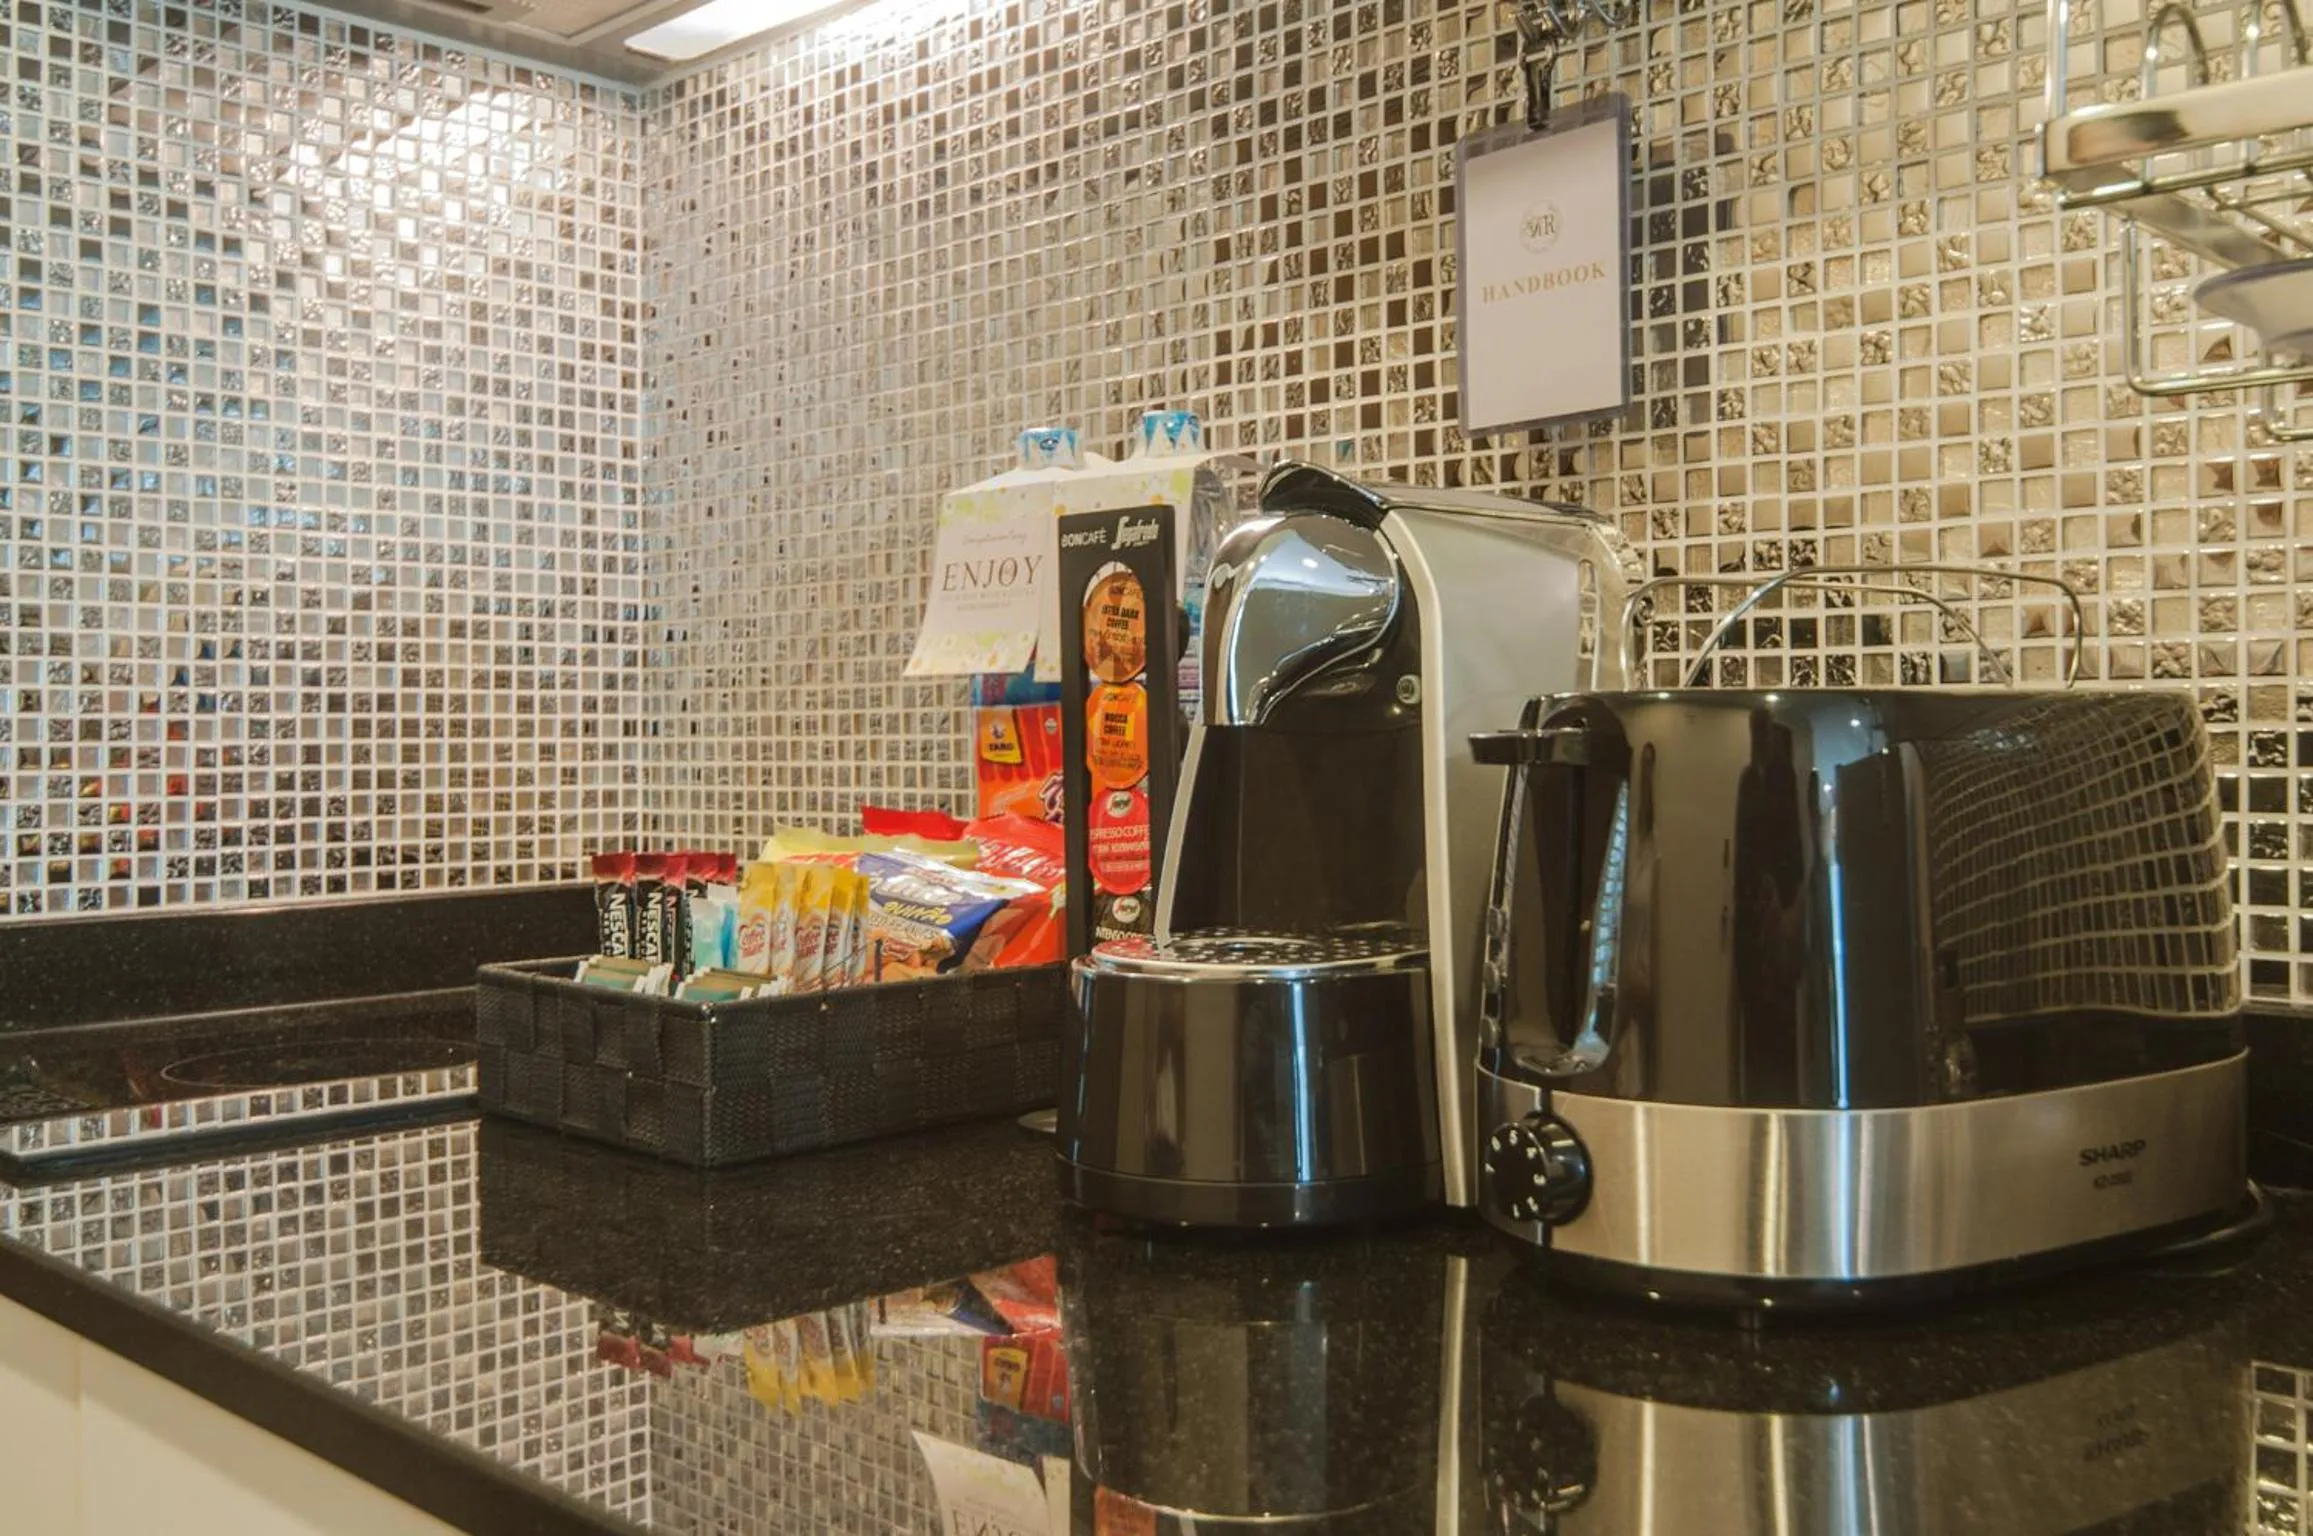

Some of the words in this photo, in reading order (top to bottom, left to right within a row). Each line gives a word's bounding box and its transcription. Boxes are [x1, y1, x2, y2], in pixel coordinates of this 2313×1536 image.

[1482, 260, 1606, 304] HANDBOOK
[941, 554, 1044, 592] ENJOY
[2078, 1139, 2146, 1167] SHARP
